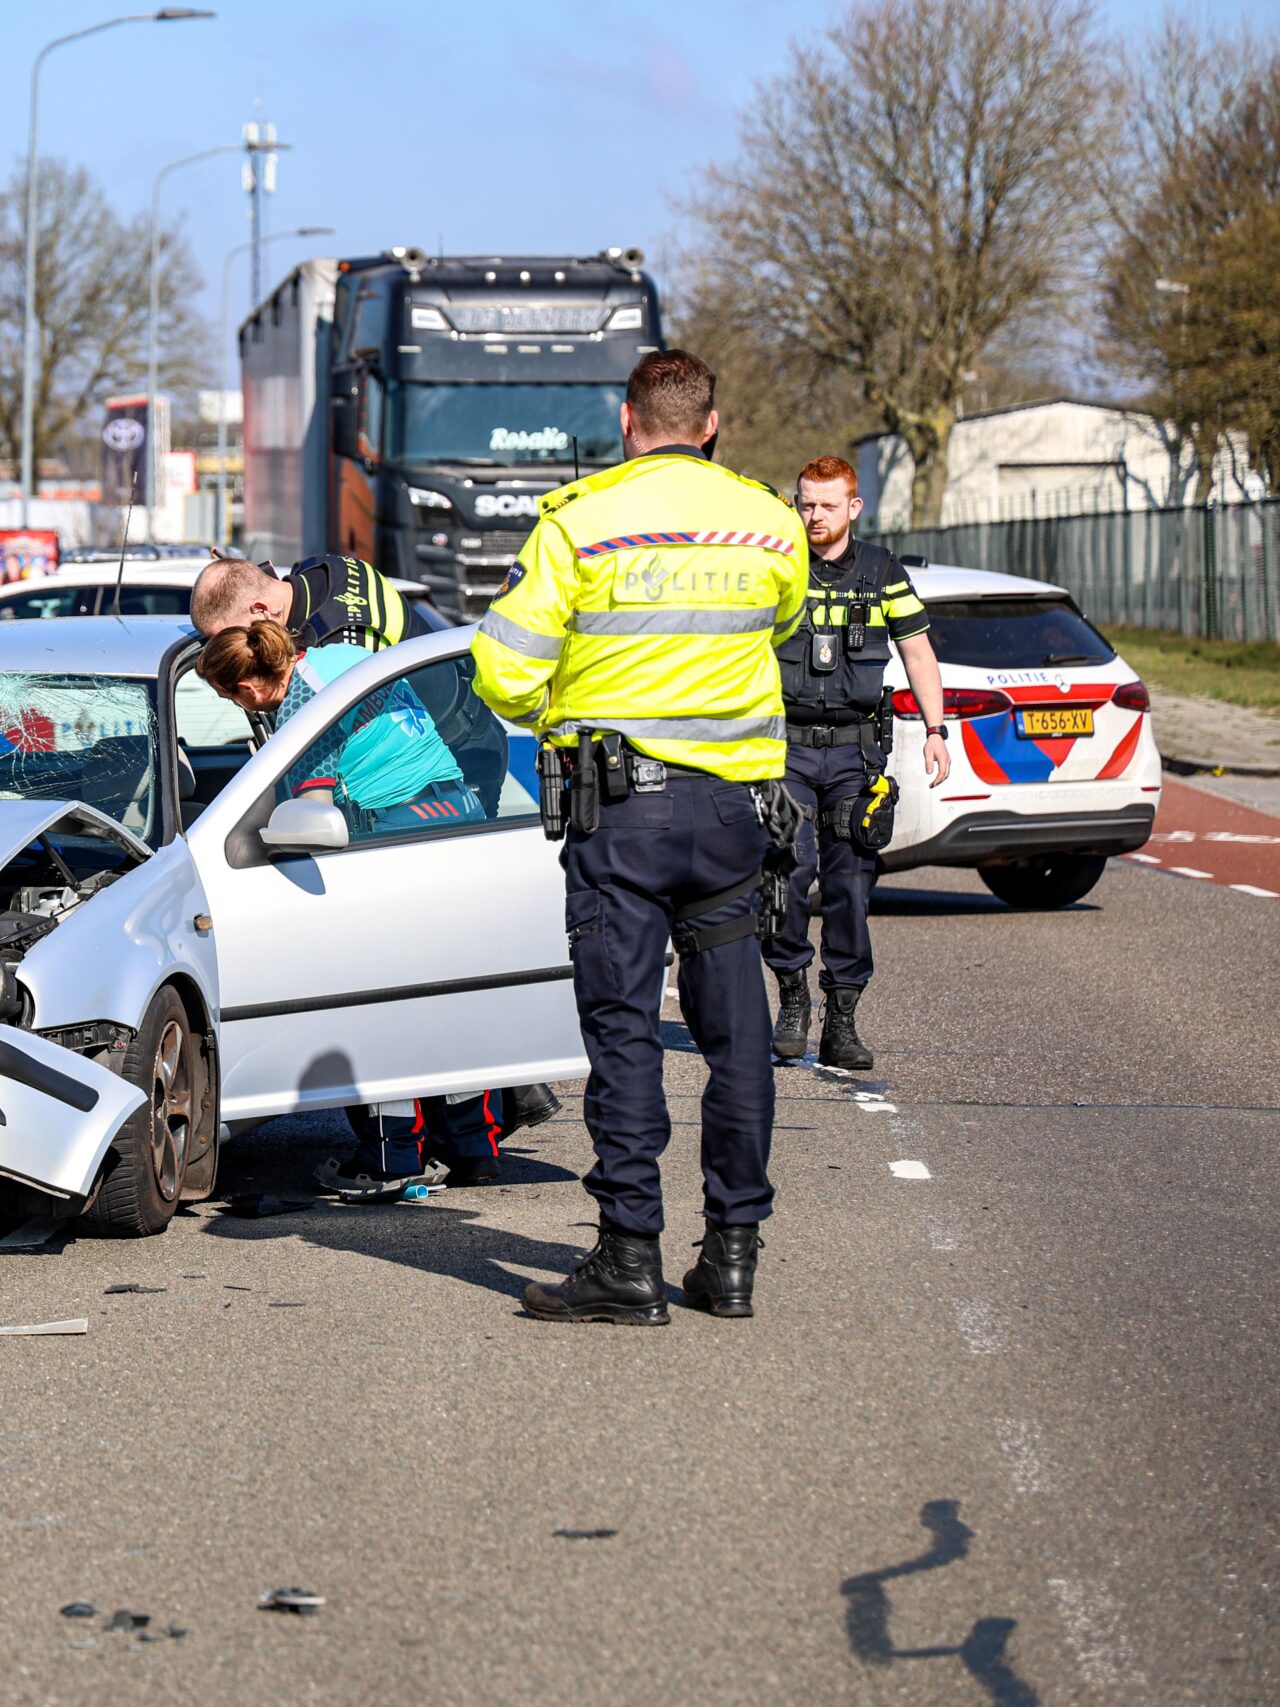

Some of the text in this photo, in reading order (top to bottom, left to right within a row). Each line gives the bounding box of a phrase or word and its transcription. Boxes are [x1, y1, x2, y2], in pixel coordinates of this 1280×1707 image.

[489, 427, 568, 450] Rosalie
[987, 672, 1049, 686] POLITIE
[1028, 711, 1088, 731] T-656-XV
